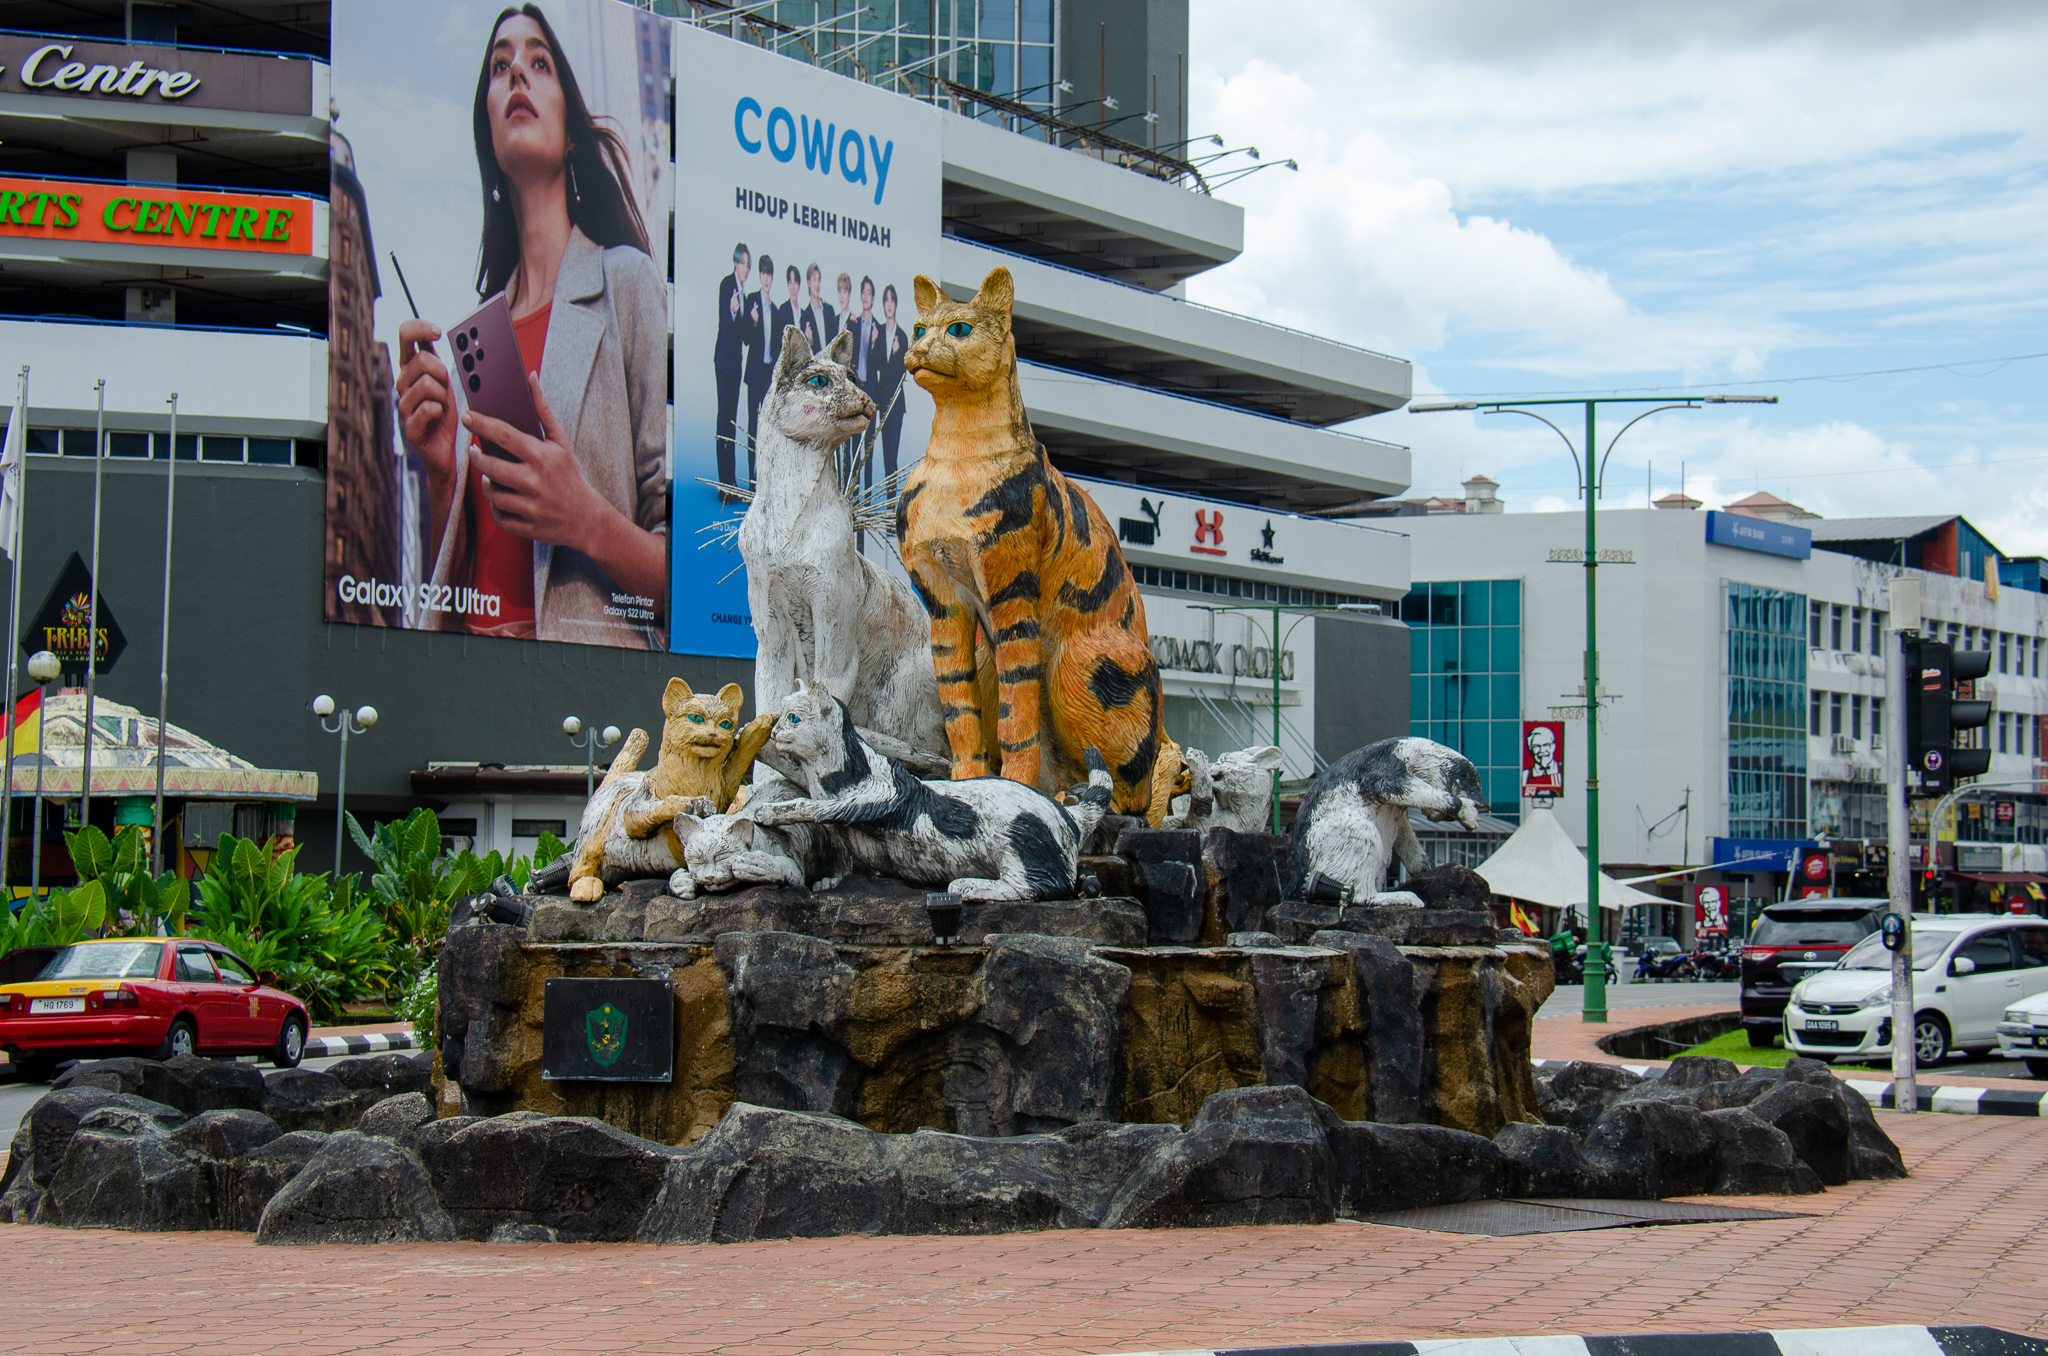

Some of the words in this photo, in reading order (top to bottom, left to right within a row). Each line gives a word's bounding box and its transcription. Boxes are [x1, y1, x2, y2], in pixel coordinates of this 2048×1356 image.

[20, 44, 200, 98] Centre
[0, 190, 82, 228] RTS
[103, 197, 293, 242] CENTRE
[736, 187, 788, 219] HIDUP
[793, 202, 837, 234] LEBIH
[842, 216, 891, 249] INDAH
[338, 574, 416, 616] Galaxy
[418, 582, 452, 612] S22
[455, 586, 500, 617] Ultra
[611, 592, 635, 605] Telefon
[635, 595, 655, 607] Pintar
[603, 605, 627, 619] Galaxy
[627, 608, 639, 619] S22
[639, 609, 655, 620] Ultra
[711, 612, 742, 625] CHANGE
[43, 627, 109, 656] TRIBS
[1147, 608, 1223, 674] rawak
[56, 1000, 74, 1010] 1769
[585, 985, 624, 1000] NORTH
